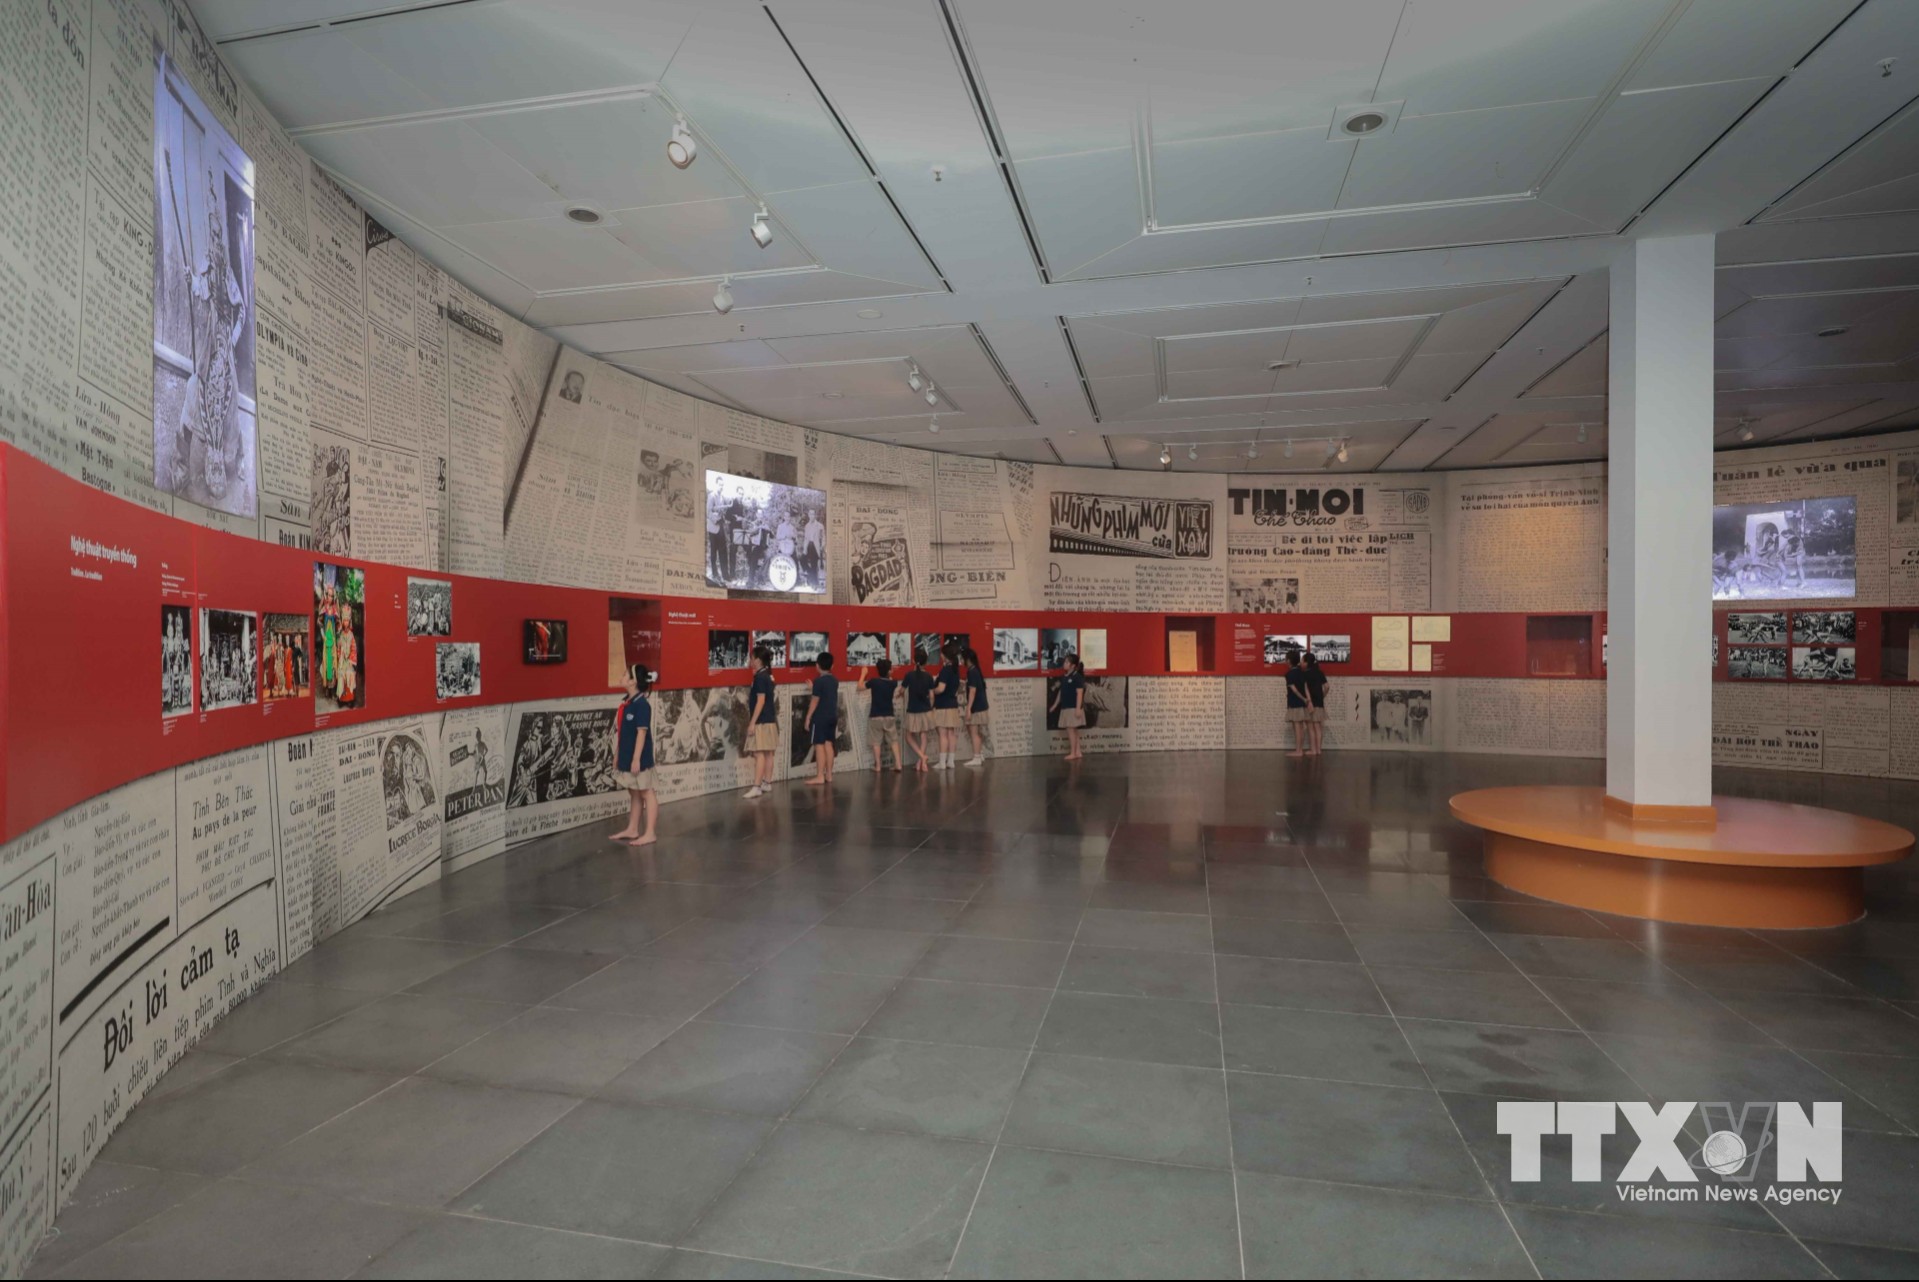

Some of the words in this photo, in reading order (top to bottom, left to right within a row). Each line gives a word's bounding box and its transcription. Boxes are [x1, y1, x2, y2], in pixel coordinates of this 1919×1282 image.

[1050, 493, 1102, 534] NHỮNG
[1102, 505, 1140, 540] PHIM
[1139, 500, 1171, 532] MỚI
[1151, 534, 1172, 548] của
[851, 558, 901, 604] BAGDAD
[204, 820, 220, 835] pays
[222, 814, 230, 826] de
[233, 811, 239, 823] la
[242, 805, 257, 820] peur
[448, 791, 482, 819] PETER
[483, 786, 506, 803] PAN
[103, 999, 134, 1074] Đôi
[146, 967, 168, 1026] lời
[180, 945, 213, 991] cảm
[225, 925, 240, 959] tạ
[60, 1158, 77, 1192] Sau
[83, 1114, 97, 1158] 120
[127, 1058, 149, 1096] chiếu
[153, 1036, 168, 1066] liên
[174, 1014, 189, 1045] tiếp
[195, 994, 214, 1026] phim
[217, 976, 236, 1001] Tình
[240, 965, 250, 982] và
[253, 946, 276, 976] Nghĩa
